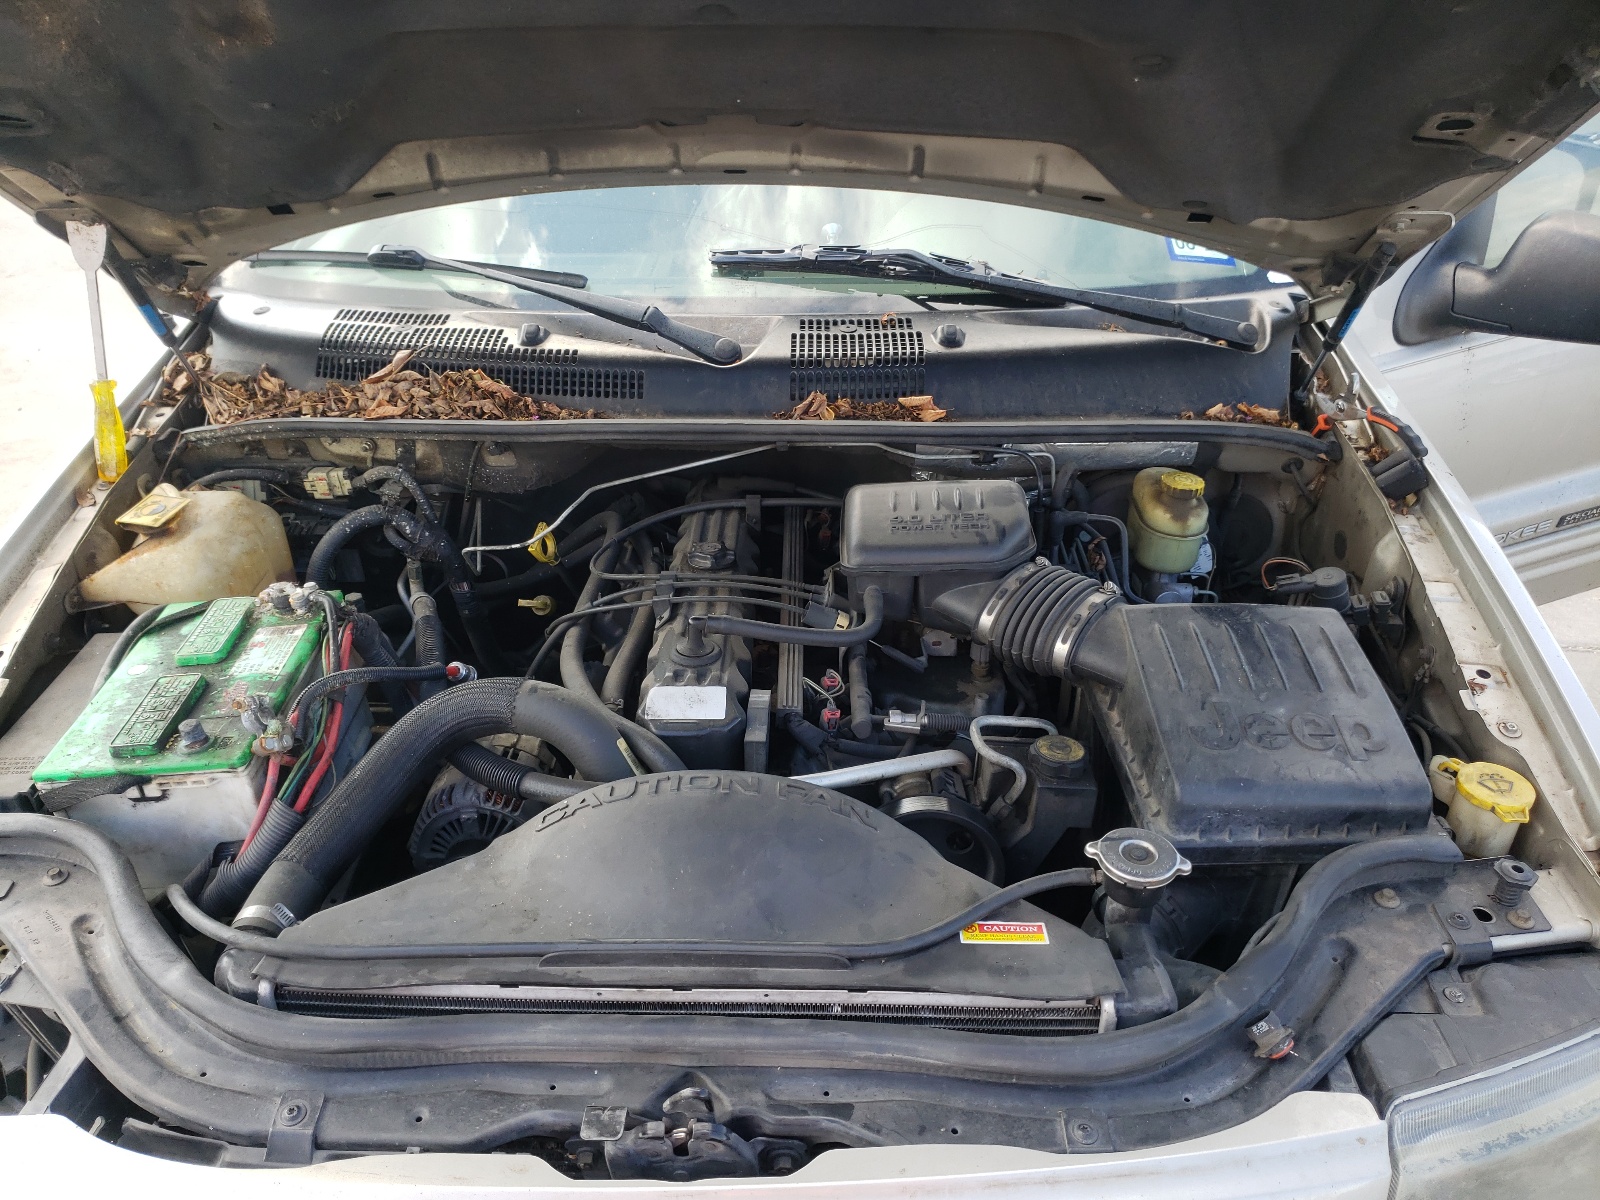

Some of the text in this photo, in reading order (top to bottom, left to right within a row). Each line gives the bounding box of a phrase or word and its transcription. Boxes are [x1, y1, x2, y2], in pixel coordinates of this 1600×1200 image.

[889, 512, 989, 523] 4.0 LITER
[889, 523, 990, 533] POWER TECH
[1189, 701, 1389, 761] Jeep
[534, 773, 880, 833] CAUTION FAN
